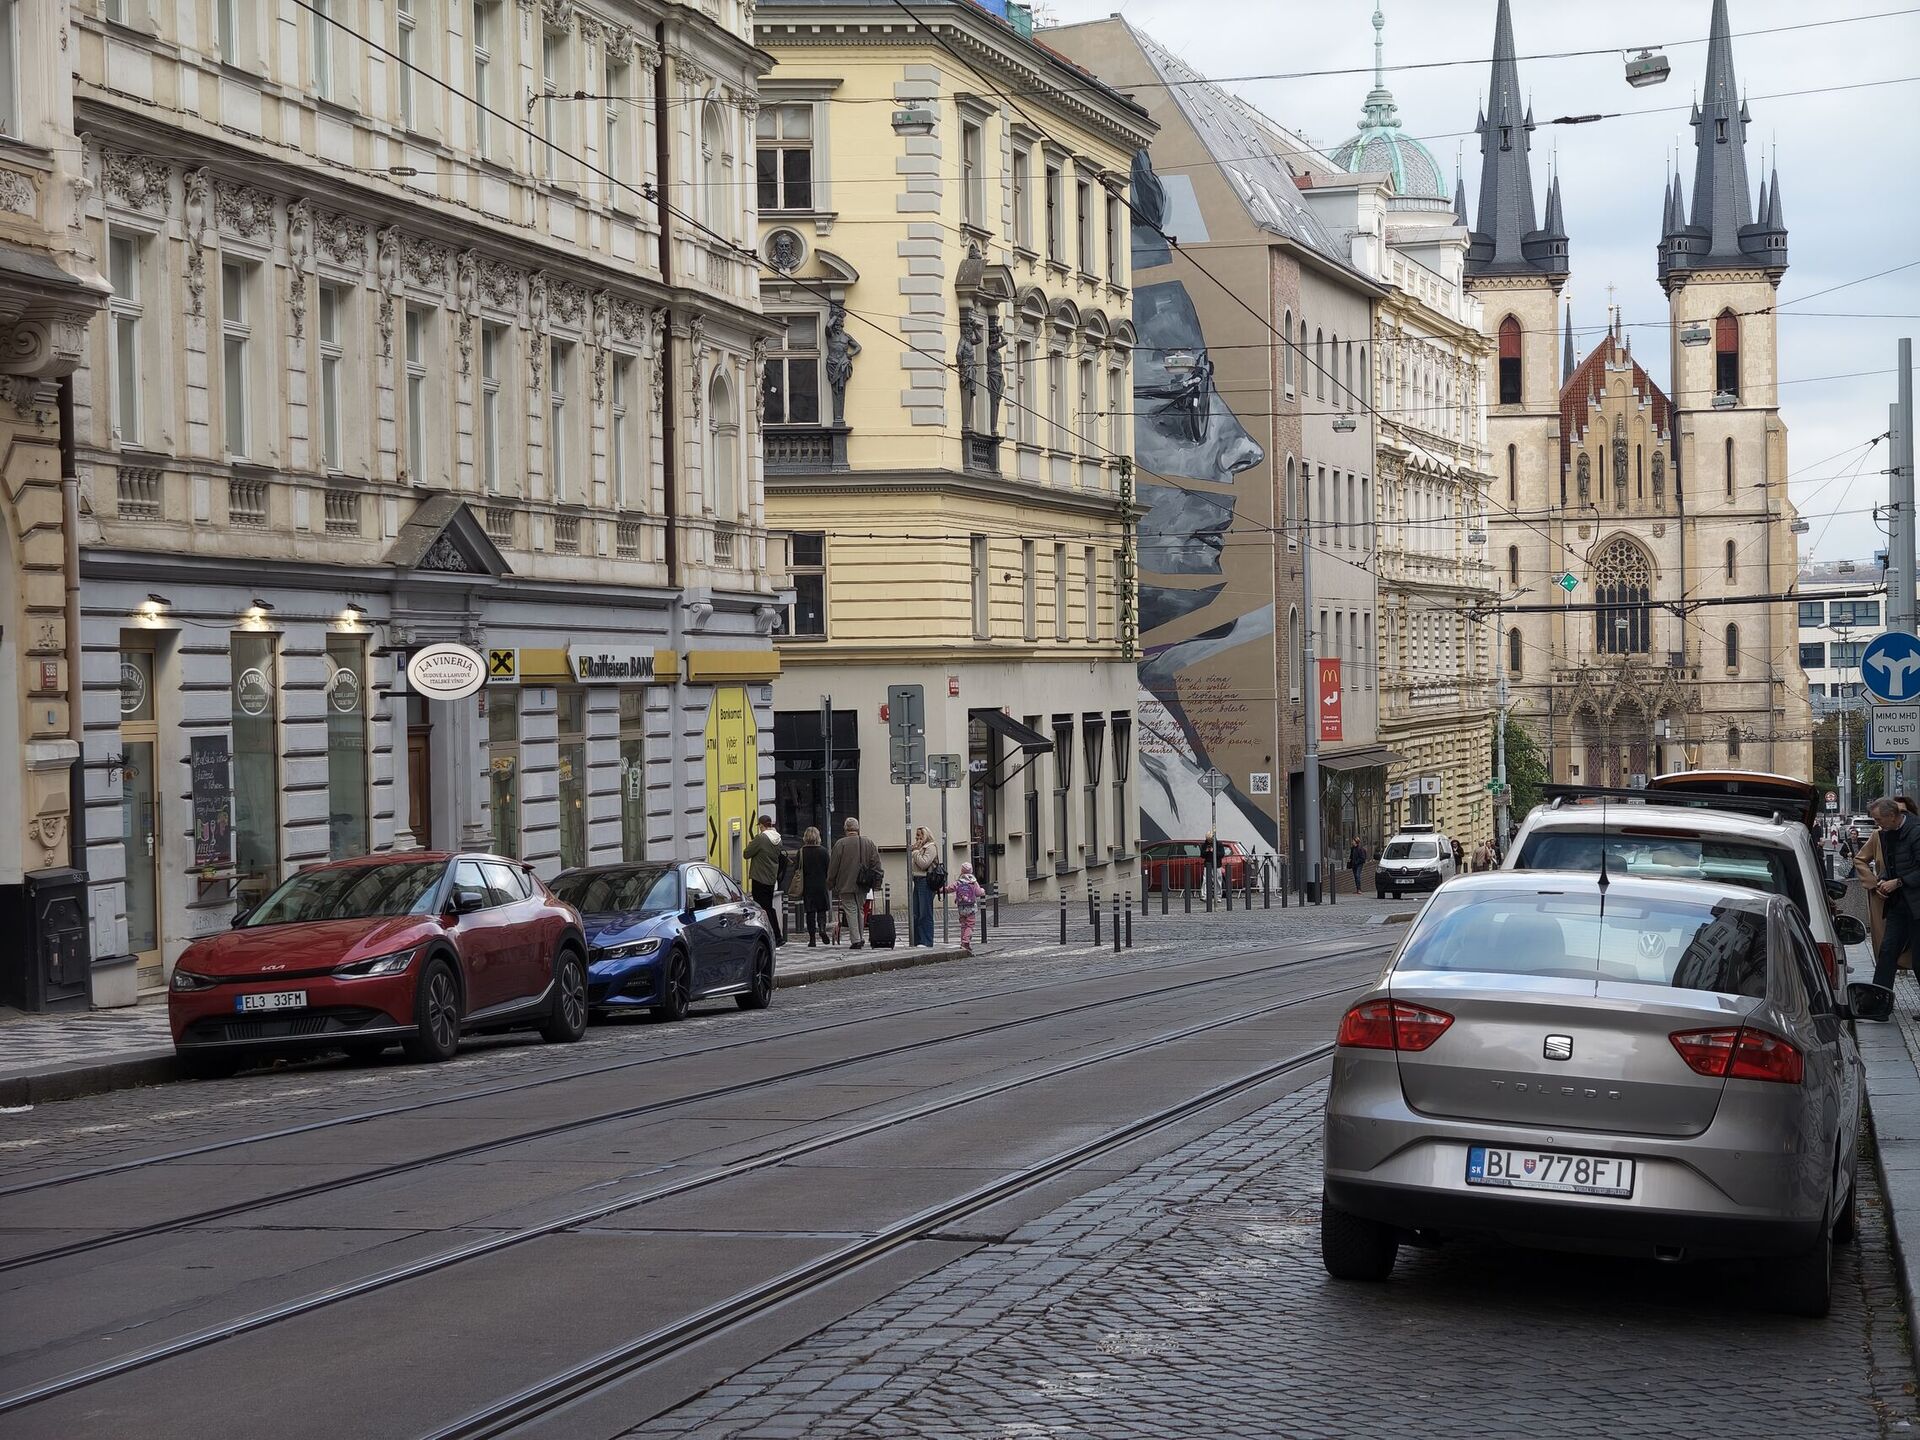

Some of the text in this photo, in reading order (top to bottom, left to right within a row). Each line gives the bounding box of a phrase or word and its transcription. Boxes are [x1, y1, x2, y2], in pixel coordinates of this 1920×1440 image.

[419, 660, 432, 672] LA
[433, 656, 473, 671] VINERIA
[588, 654, 654, 677] Raiffeisen BANK
[720, 708, 742, 720] Bankomat
[1875, 711, 1918, 720] MIMO MHD
[1878, 723, 1916, 733] CYKLISTŮ
[707, 738, 716, 750] ATM
[747, 734, 756, 746] ATM
[1885, 738, 1910, 746] A BUS
[245, 995, 266, 1009] EL3
[273, 992, 302, 1007] 33FM
[1490, 1079, 1622, 1101] TOLEDO
[1471, 1165, 1482, 1174] SK
[1487, 1150, 1521, 1179] BL
